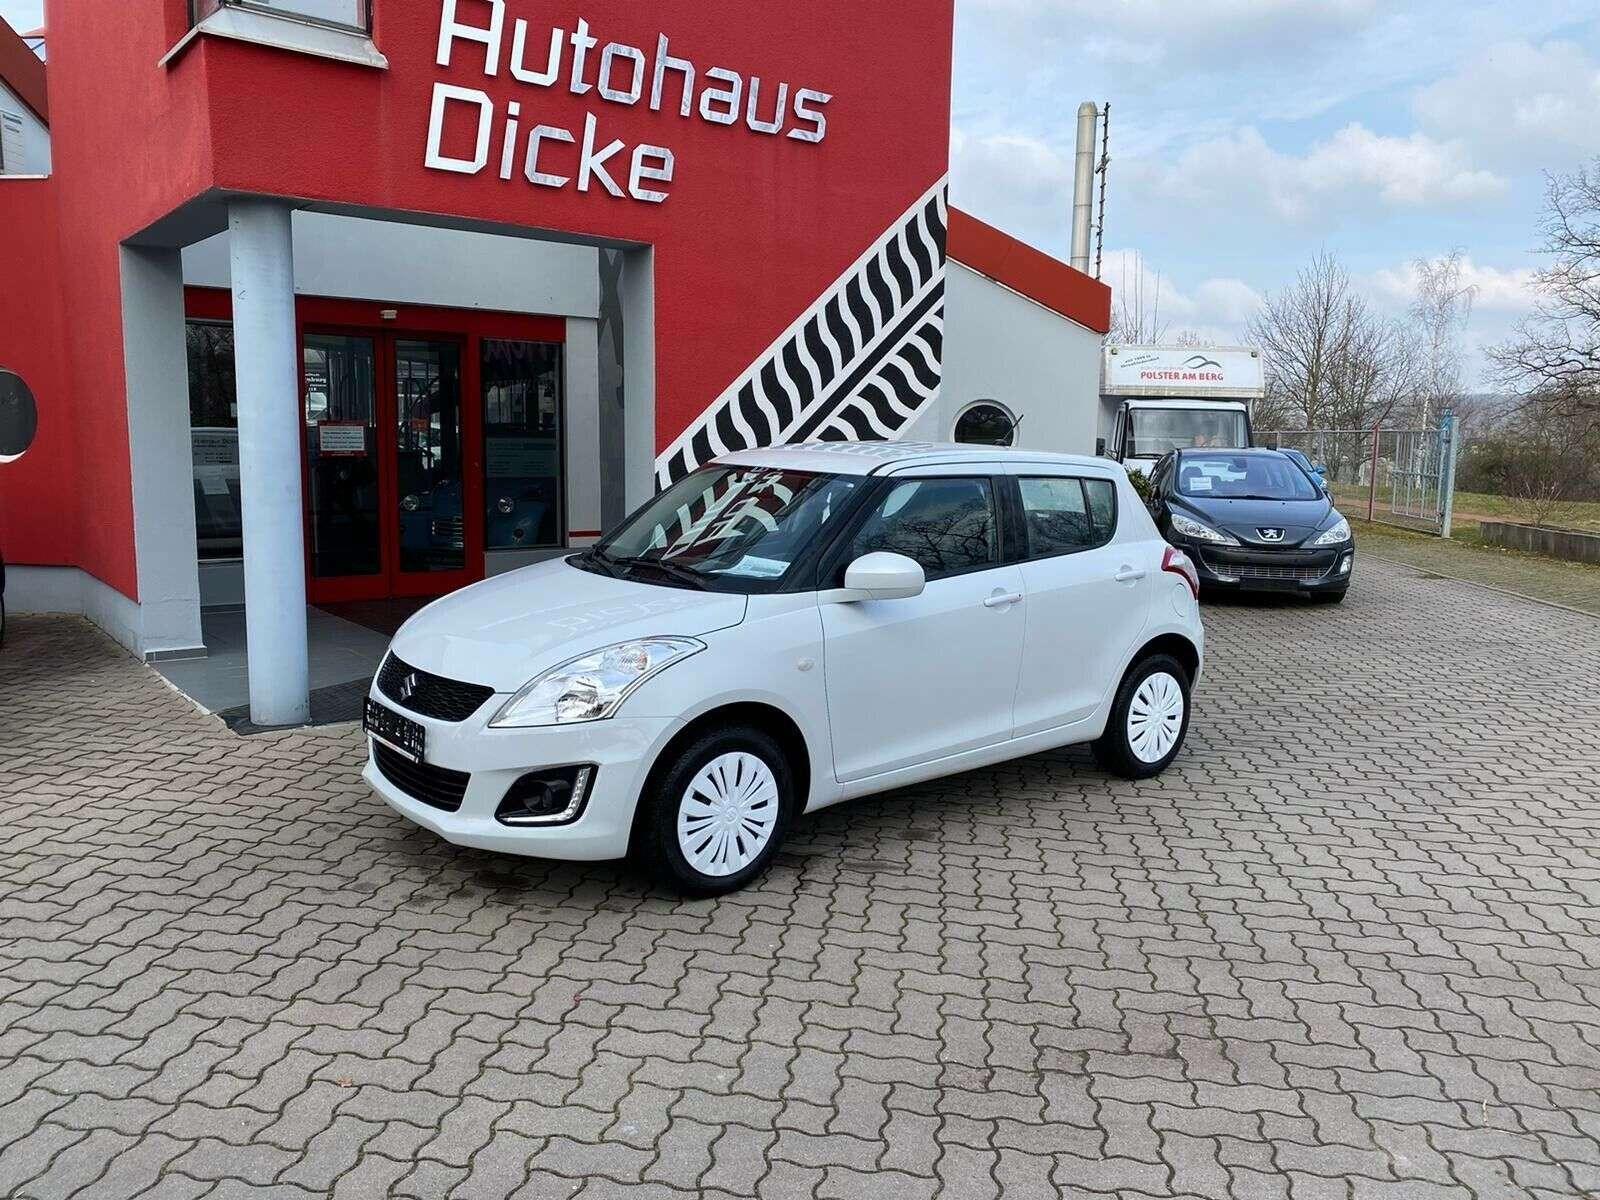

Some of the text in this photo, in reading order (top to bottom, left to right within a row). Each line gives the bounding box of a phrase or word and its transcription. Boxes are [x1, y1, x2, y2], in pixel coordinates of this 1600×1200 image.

[436, 0, 833, 143] Autohaus
[424, 82, 675, 203] Dicke
[1140, 371, 1224, 381] POLSTER AM BERG
